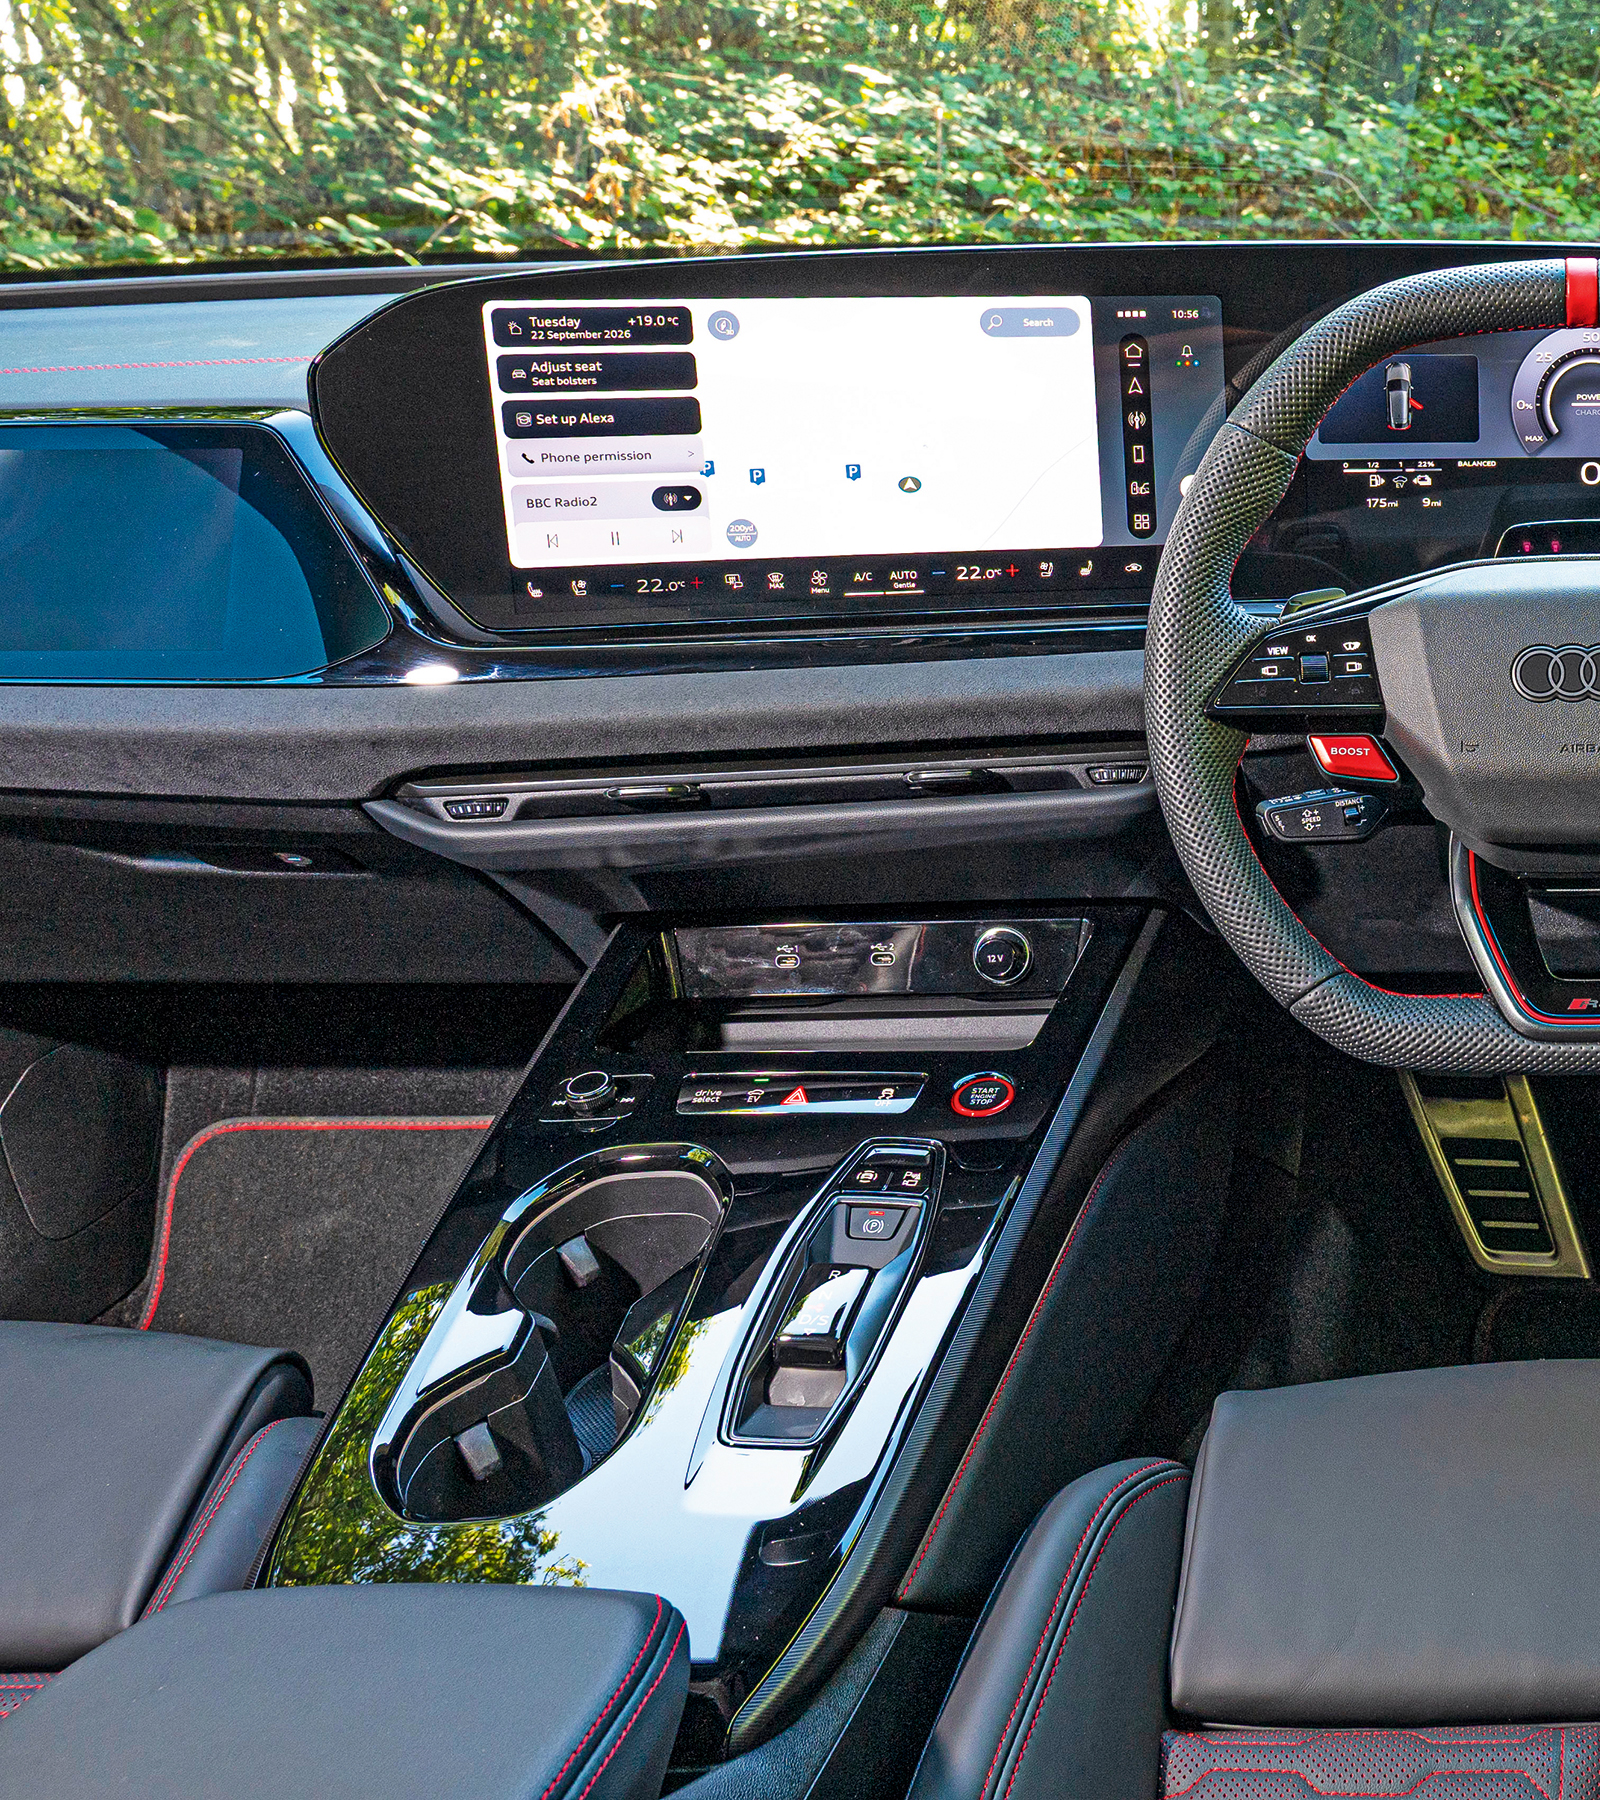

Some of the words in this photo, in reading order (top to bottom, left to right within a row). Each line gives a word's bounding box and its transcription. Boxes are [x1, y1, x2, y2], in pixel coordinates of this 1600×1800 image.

[1172, 310, 1199, 318] 10:56
[529, 316, 581, 330] Tuesday
[628, 315, 665, 326] +19.0
[1023, 318, 1054, 327] Search
[531, 330, 544, 340] 22
[547, 330, 602, 341] September
[604, 330, 631, 338] 2026
[1582, 332, 1600, 342] 50
[1535, 352, 1552, 363] 25
[531, 362, 572, 374] Adjust
[575, 362, 602, 372] seat
[532, 376, 554, 386] Seat
[556, 376, 598, 386] bolsters
[1516, 400, 1533, 410] 0%
[536, 414, 558, 424] Set
[561, 416, 576, 426] up
[580, 413, 615, 424] Alexa
[541, 452, 580, 462] Phone
[584, 450, 652, 464] permission
[526, 498, 552, 508] BBC
[555, 496, 598, 508] Radio2
[730, 524, 754, 534] 200yd
[854, 570, 873, 582] A/C
[890, 570, 918, 580] AUTO
[811, 586, 830, 594] Menu
[1306, 634, 1316, 642] OK
[1267, 646, 1288, 656] VIEW
[1330, 747, 1370, 756] BOOST
[1335, 798, 1363, 807] DISTANCE
[1302, 816, 1322, 824] SPEED
[829, 1270, 840, 1280] R
[819, 1290, 832, 1300] N
[799, 1314, 829, 1326] D/S
